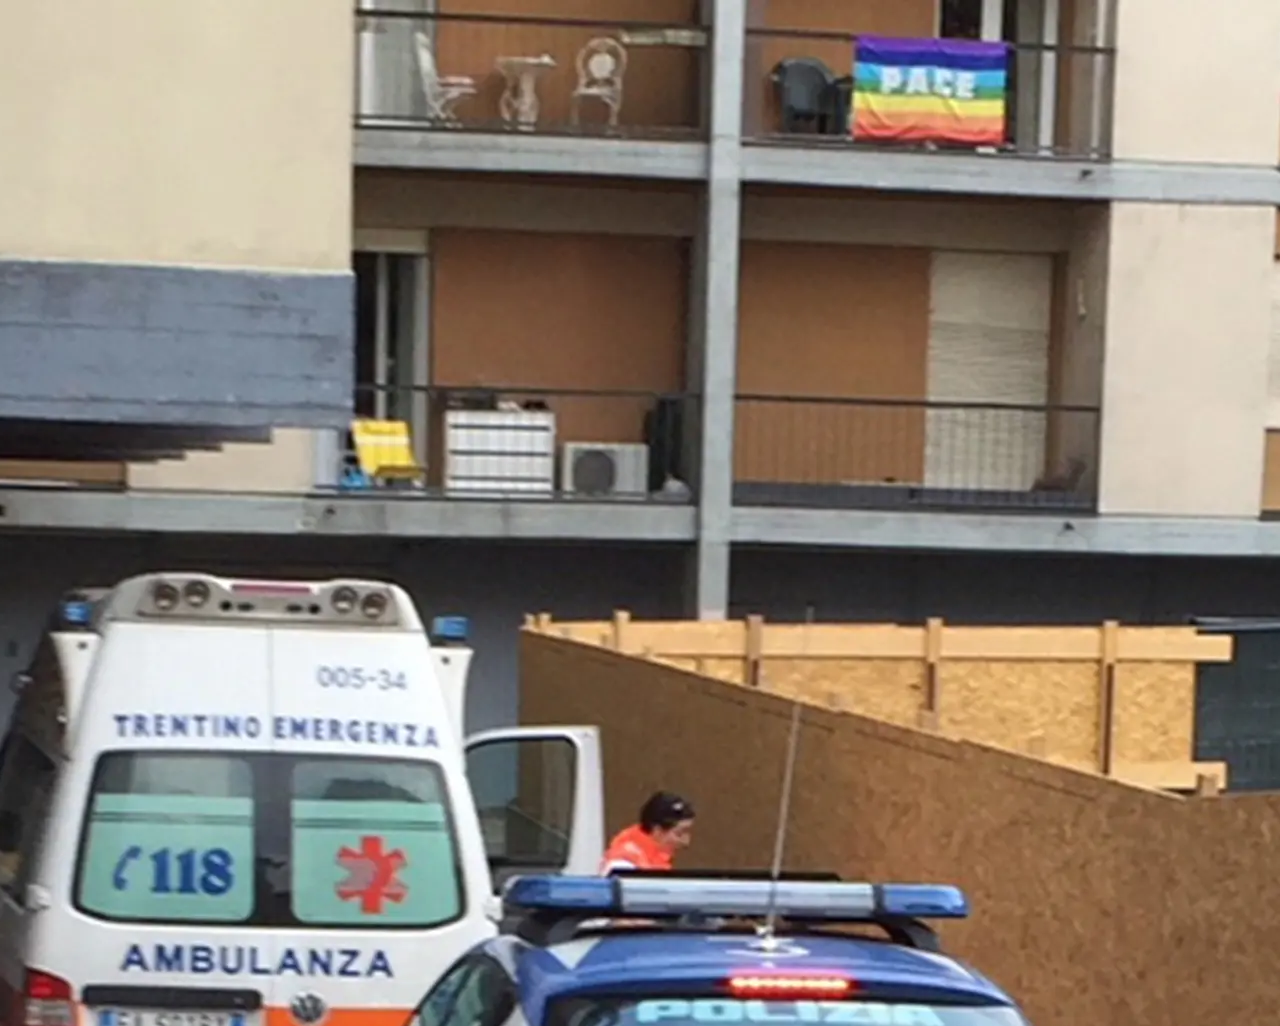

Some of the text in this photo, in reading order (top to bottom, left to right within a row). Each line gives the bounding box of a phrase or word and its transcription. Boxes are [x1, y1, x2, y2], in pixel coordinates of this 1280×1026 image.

[880, 66, 976, 98] PACE
[316, 665, 408, 691] 005-34
[113, 714, 440, 749] TRENTINO EMERGENZA
[149, 847, 235, 897] 118
[119, 943, 395, 979] AMBULANZA
